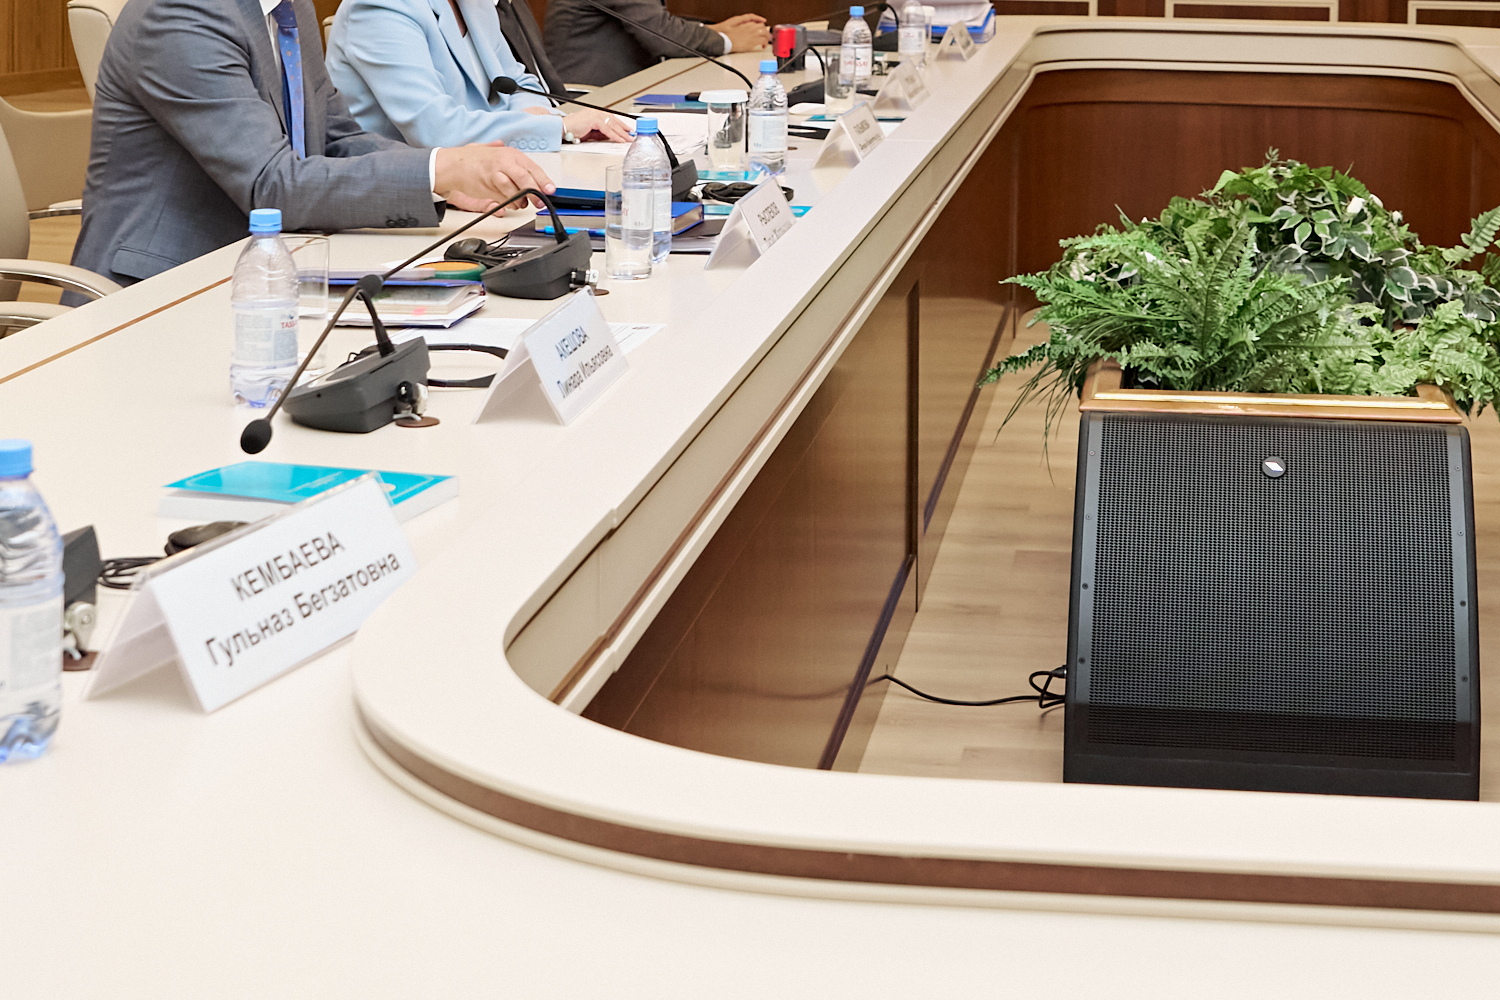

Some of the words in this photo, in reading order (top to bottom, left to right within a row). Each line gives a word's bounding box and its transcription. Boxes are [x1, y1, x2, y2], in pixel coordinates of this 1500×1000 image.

[555, 325, 590, 361] АКЕШОВА
[230, 531, 346, 602] КЕМБАЕВА
[205, 607, 295, 667] Гульназ
[293, 552, 401, 619] Бегзатовна
